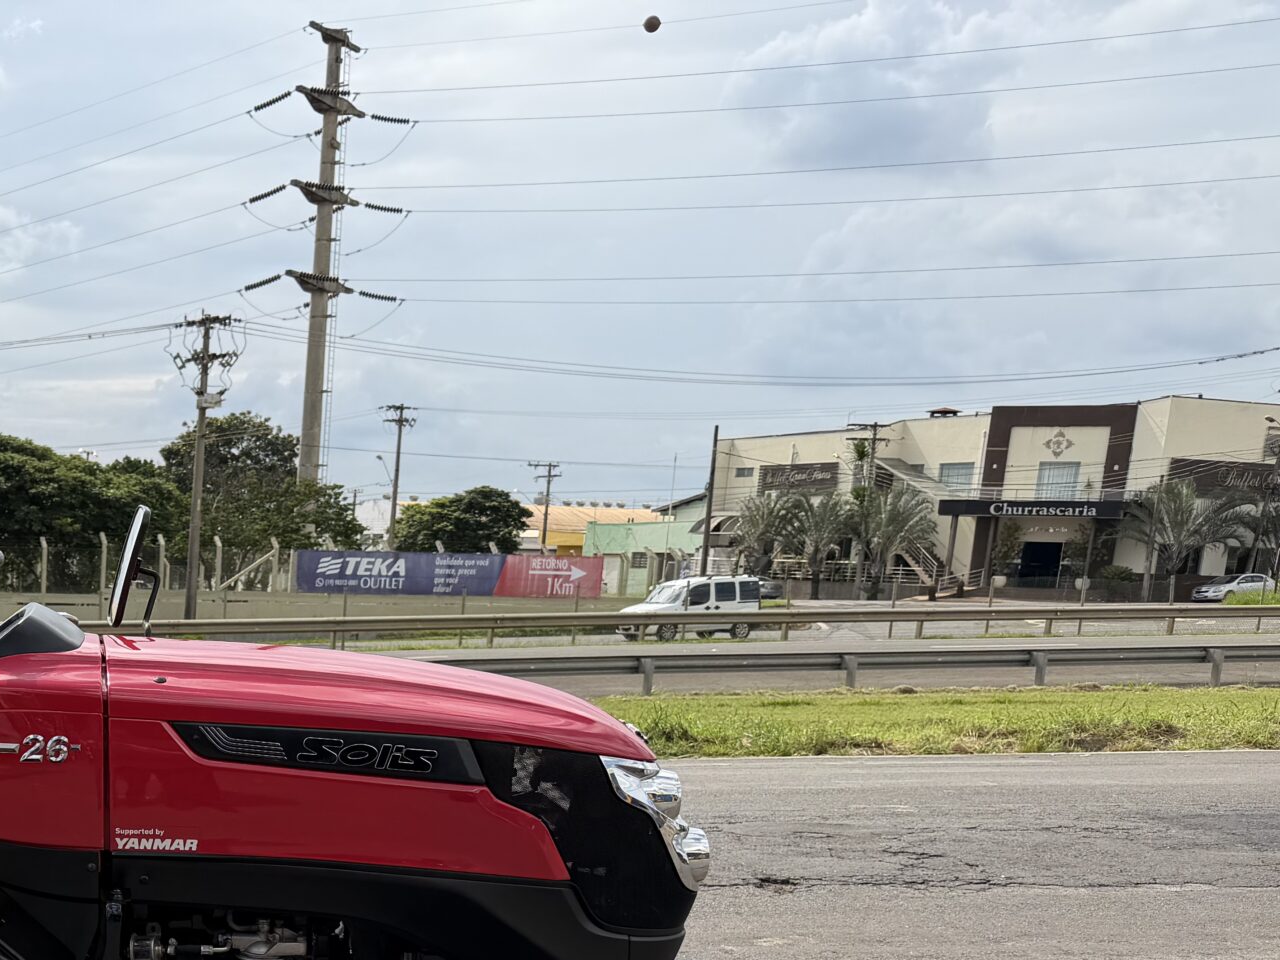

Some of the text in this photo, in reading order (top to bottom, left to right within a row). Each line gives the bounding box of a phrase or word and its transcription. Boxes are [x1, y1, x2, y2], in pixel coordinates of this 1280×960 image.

[989, 502, 1097, 516] Churrascaria
[345, 557, 406, 576] TEKA
[435, 556, 463, 566] Qualidade
[464, 559, 475, 567] que
[531, 559, 568, 569] RETORNO
[360, 577, 405, 589] OUTLET
[20, 734, 69, 763] 26
[296, 736, 438, 773] Solis
[115, 827, 165, 836] Supported by
[115, 837, 198, 851] YANMAR
